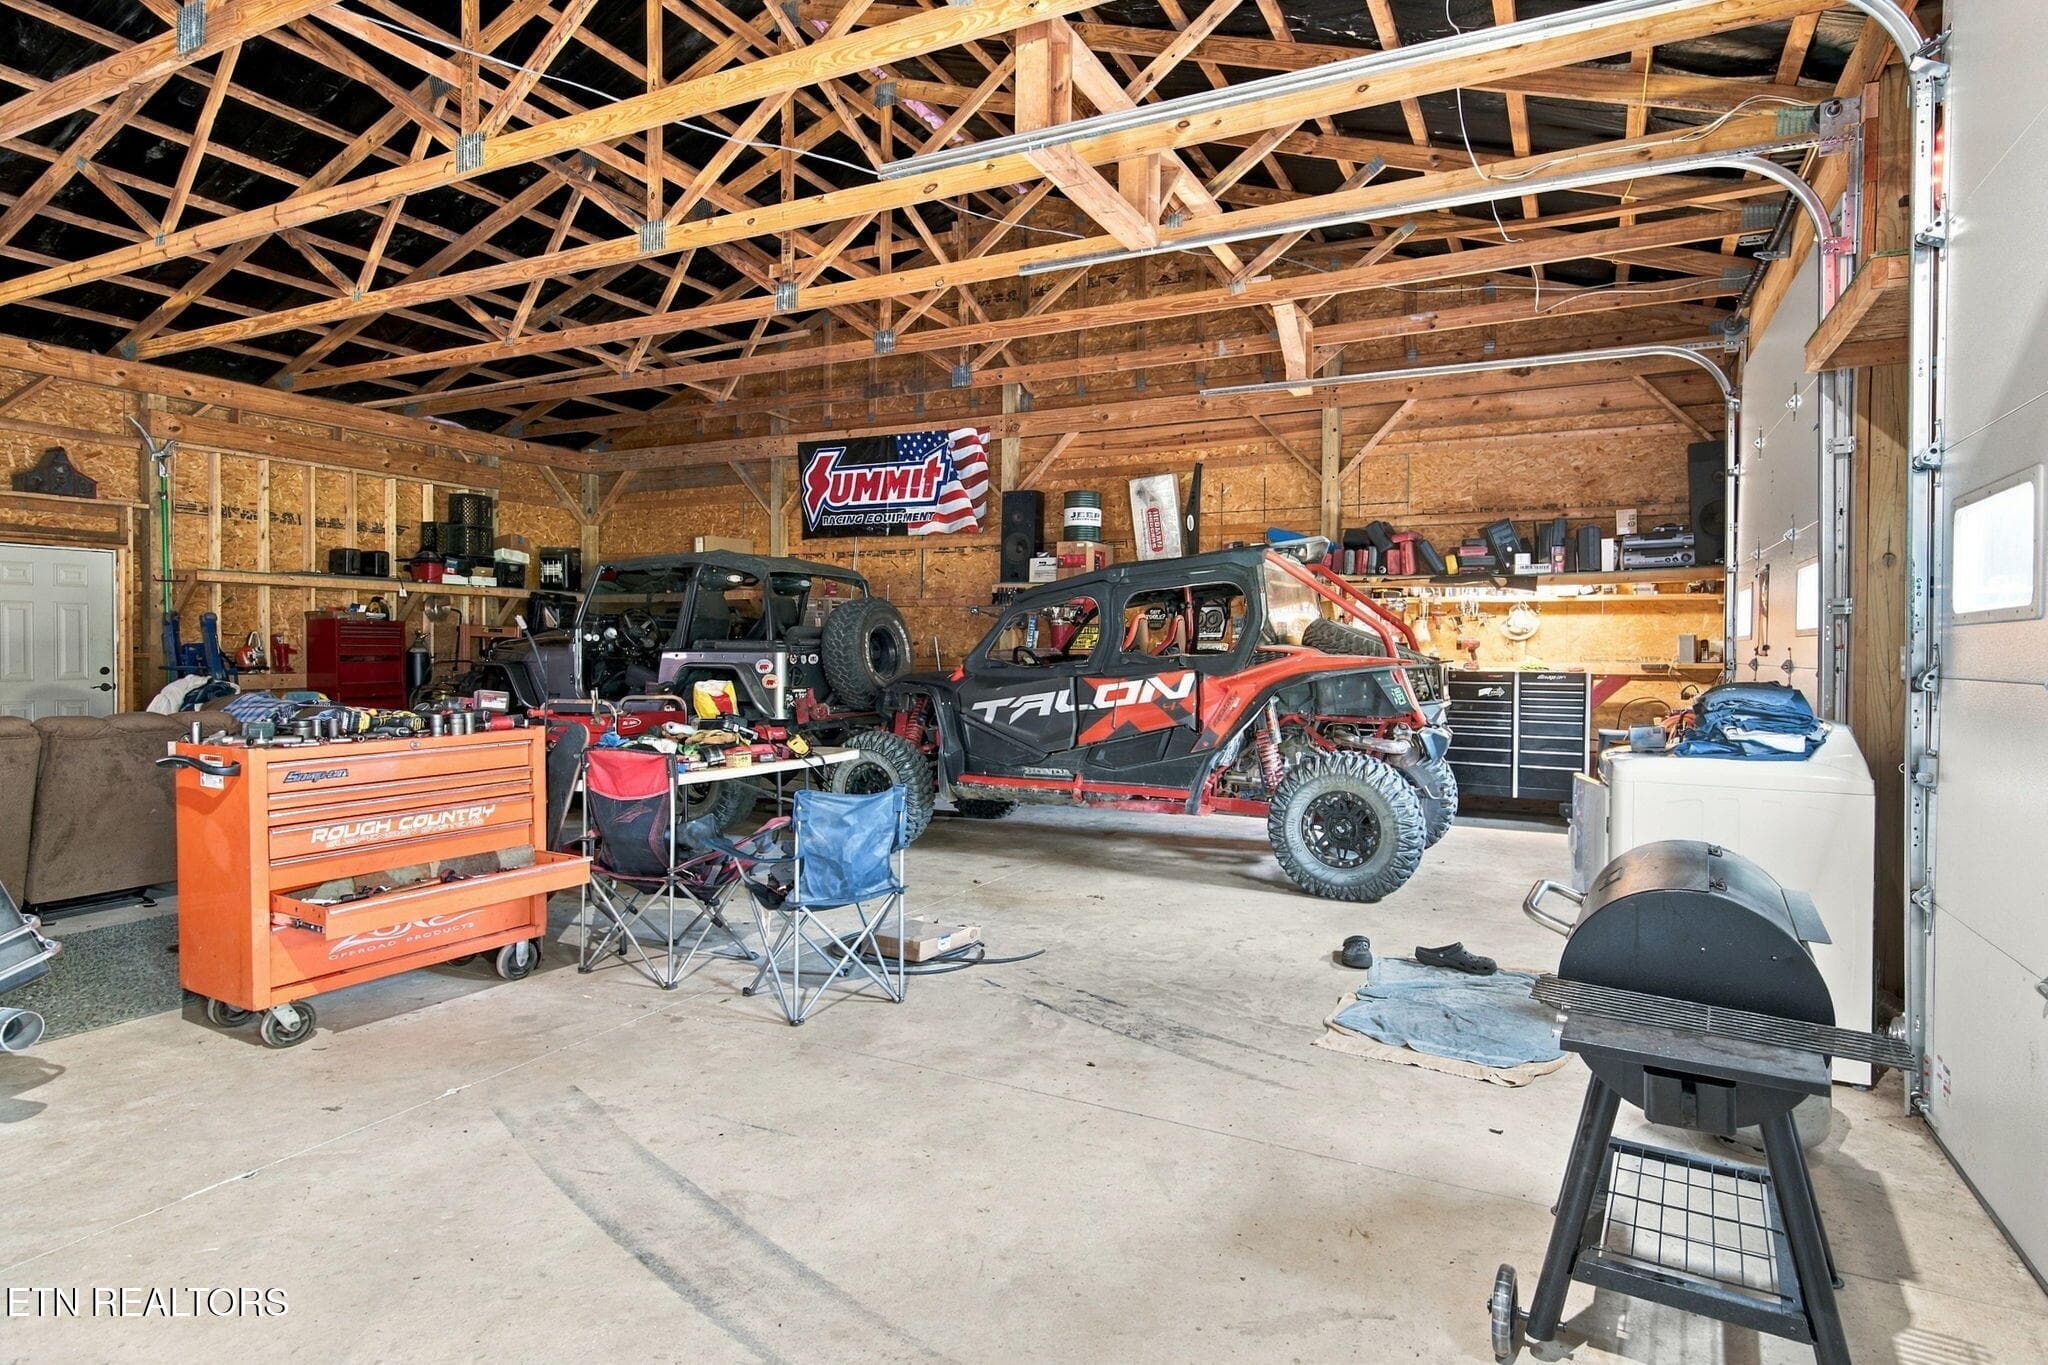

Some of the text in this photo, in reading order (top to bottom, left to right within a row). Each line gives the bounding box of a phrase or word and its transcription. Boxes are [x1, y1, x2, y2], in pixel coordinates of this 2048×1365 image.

[822, 511, 935, 526] RACING EQUIPMENT
[1070, 511, 1100, 519] JEEP
[972, 672, 1196, 724] TALON
[1023, 767, 1072, 776] HONDA
[311, 819, 391, 843] ROUGH
[398, 804, 496, 830] COUNTRY
[328, 921, 475, 961] OFFROAD PRODUCTS
